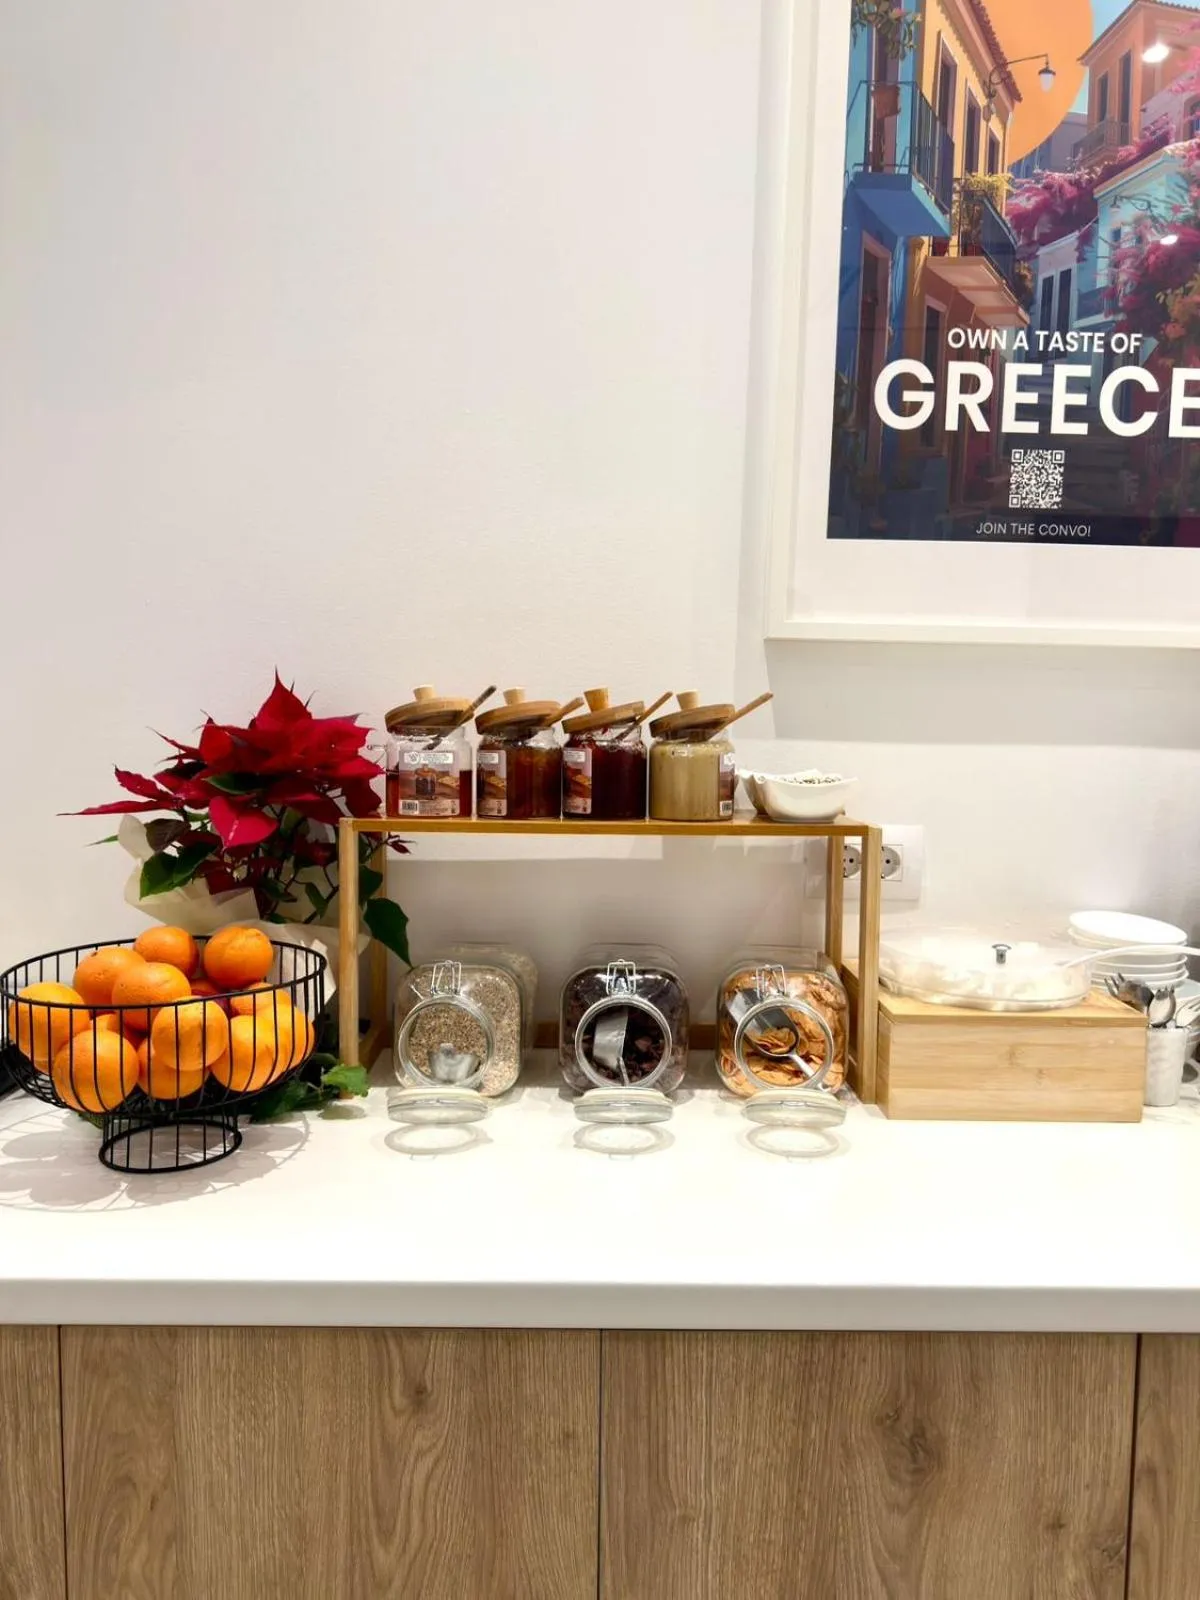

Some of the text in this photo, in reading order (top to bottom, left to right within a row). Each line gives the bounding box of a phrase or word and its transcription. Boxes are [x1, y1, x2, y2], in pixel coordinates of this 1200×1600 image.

[948, 327, 1143, 354] OWN A TASTE OF
[874, 359, 1200, 438] GREECE
[976, 522, 1091, 537] JOIN THE CONVO!
